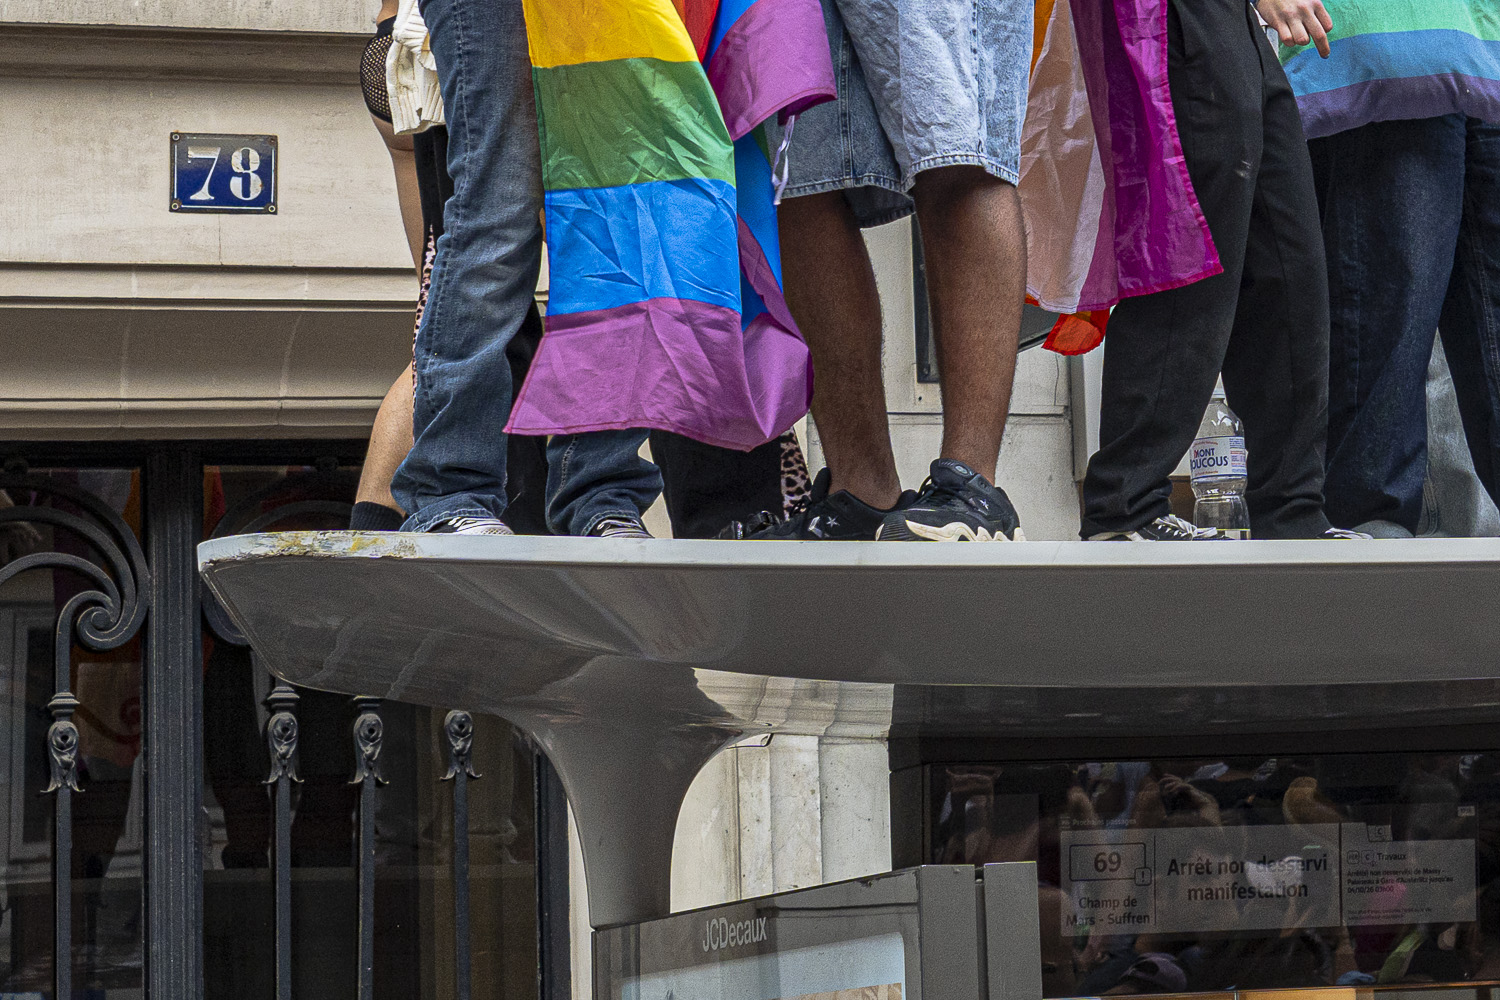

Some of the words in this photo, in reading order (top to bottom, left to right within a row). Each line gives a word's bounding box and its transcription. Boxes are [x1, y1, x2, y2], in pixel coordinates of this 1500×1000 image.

[187, 146, 263, 201] 78
[1194, 448, 1215, 458] MONT
[1094, 852, 1121, 872] 69
[1167, 856, 1212, 876] Arrêt
[1218, 860, 1250, 875] non
[1259, 854, 1327, 874] desservi
[1377, 852, 1406, 861] Travaux
[1188, 881, 1308, 902] manifestation
[1078, 896, 1120, 910] Champ
[1123, 896, 1137, 908] de
[1066, 913, 1095, 927] Mars
[1107, 911, 1150, 925] Suffren
[702, 916, 767, 953] JCDecaux
